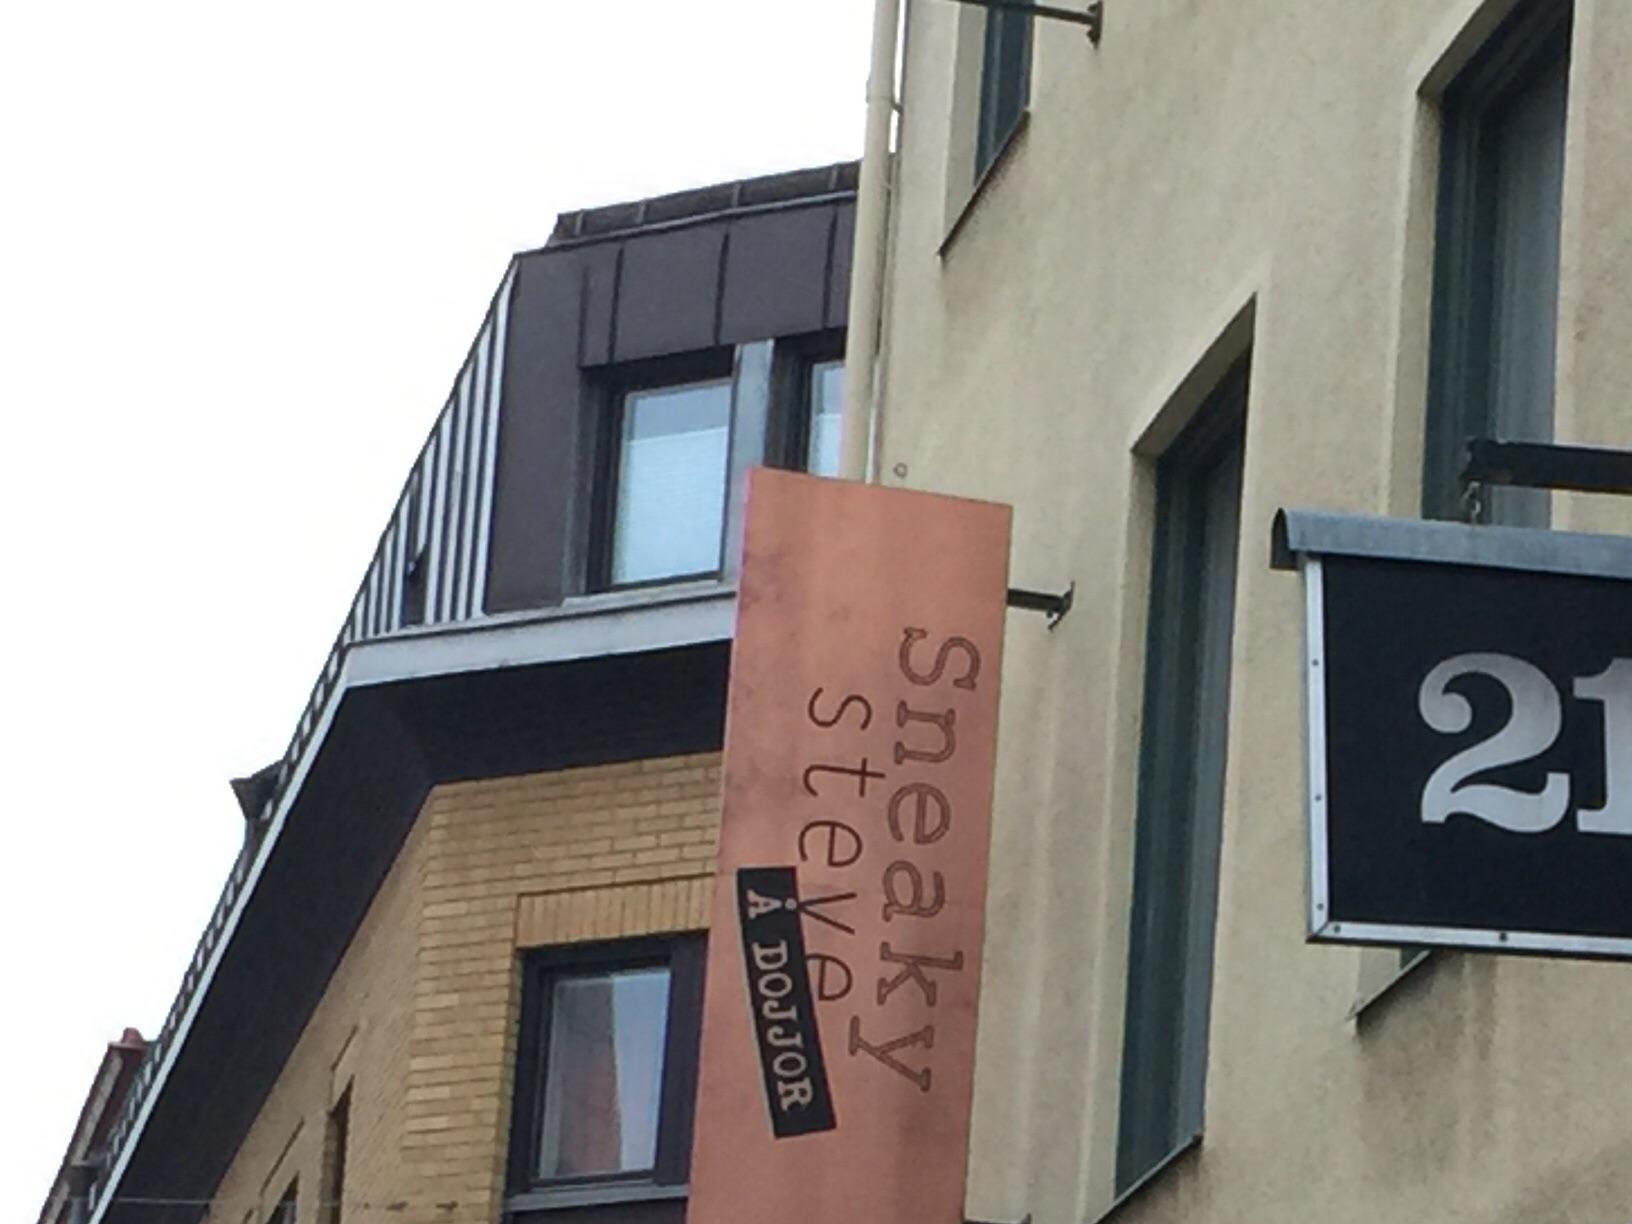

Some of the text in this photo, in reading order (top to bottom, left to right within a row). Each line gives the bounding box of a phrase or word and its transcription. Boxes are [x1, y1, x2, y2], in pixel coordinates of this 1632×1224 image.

[746, 887, 814, 1113] Å DOJJOR
[850, 625, 982, 1094] Sneaky
